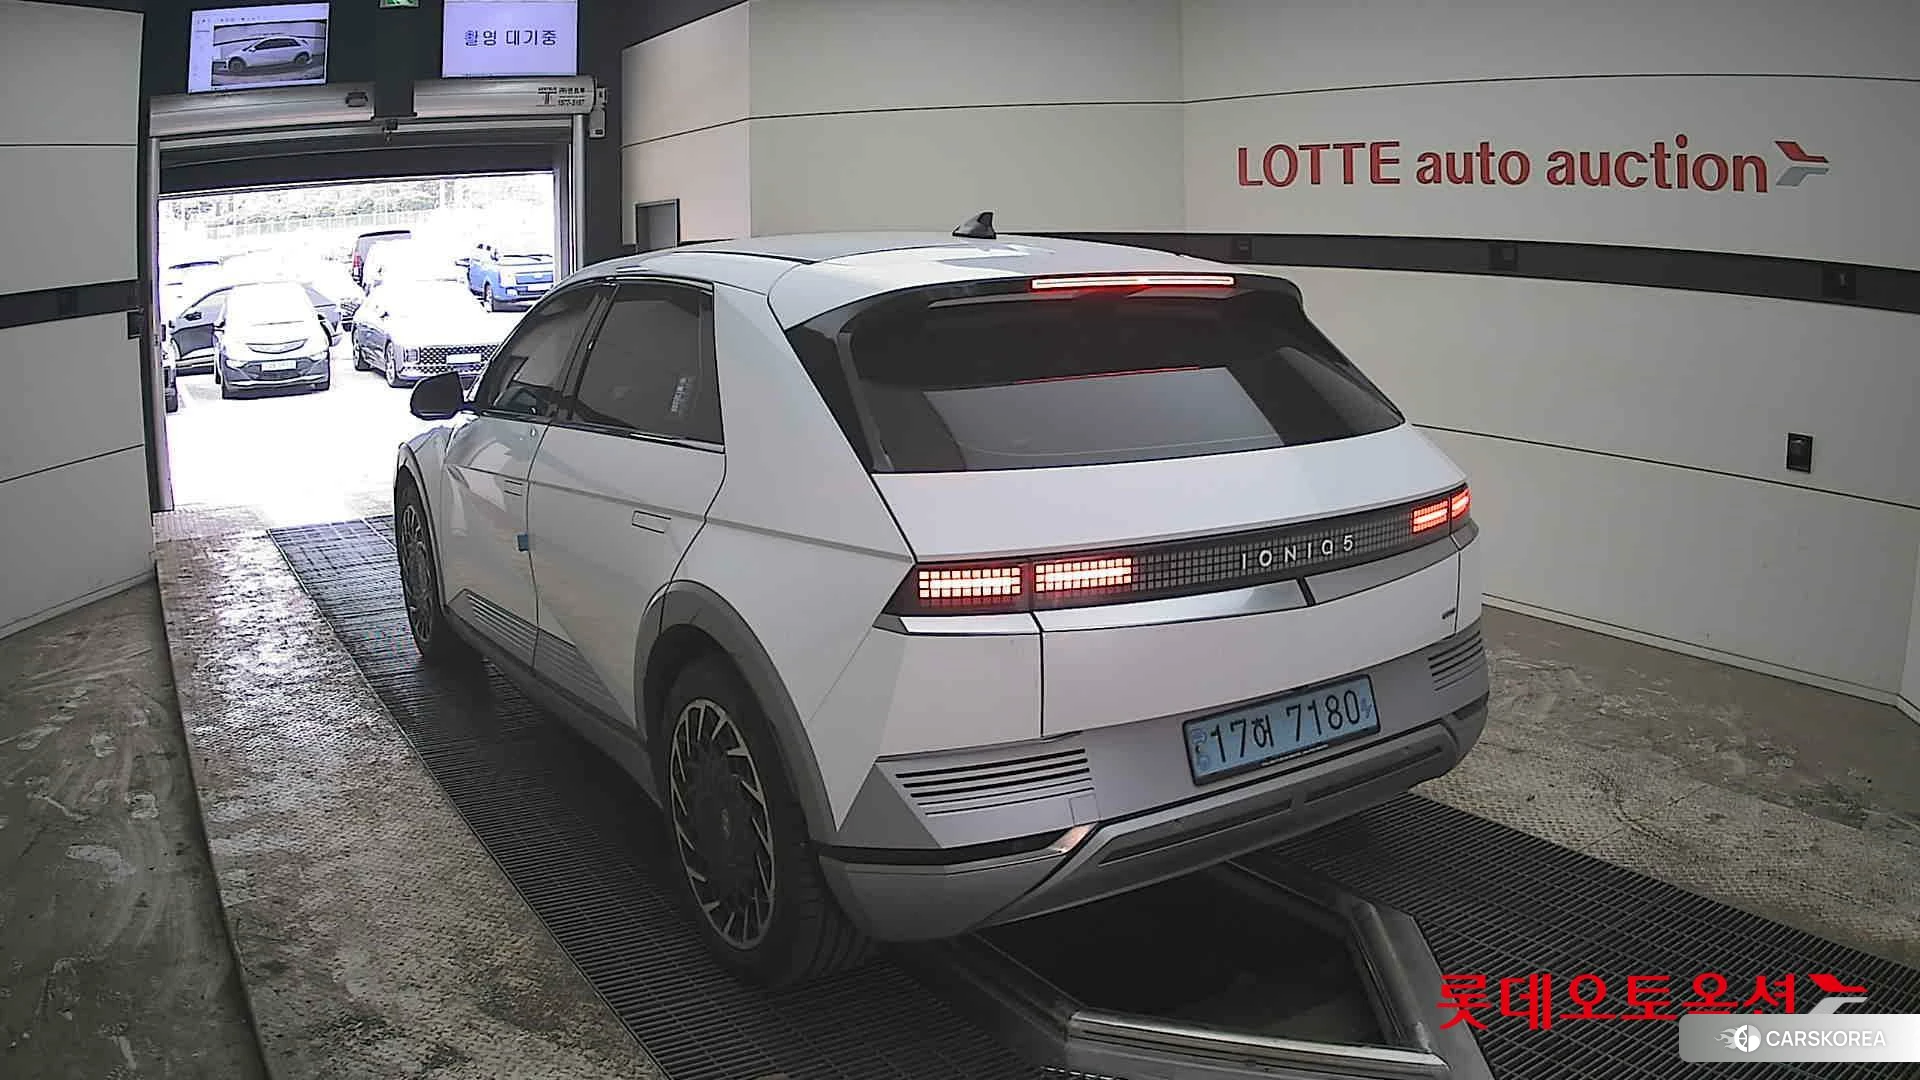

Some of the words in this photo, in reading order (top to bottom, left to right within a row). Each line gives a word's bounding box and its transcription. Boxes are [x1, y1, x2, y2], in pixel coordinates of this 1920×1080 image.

[505, 29, 557, 47] 대기중
[1237, 140, 1400, 187] LOTTE
[1415, 141, 1531, 186] auto
[1546, 134, 1769, 194] auction
[1210, 713, 1275, 764] 17허
[1285, 689, 1361, 743] 7180
